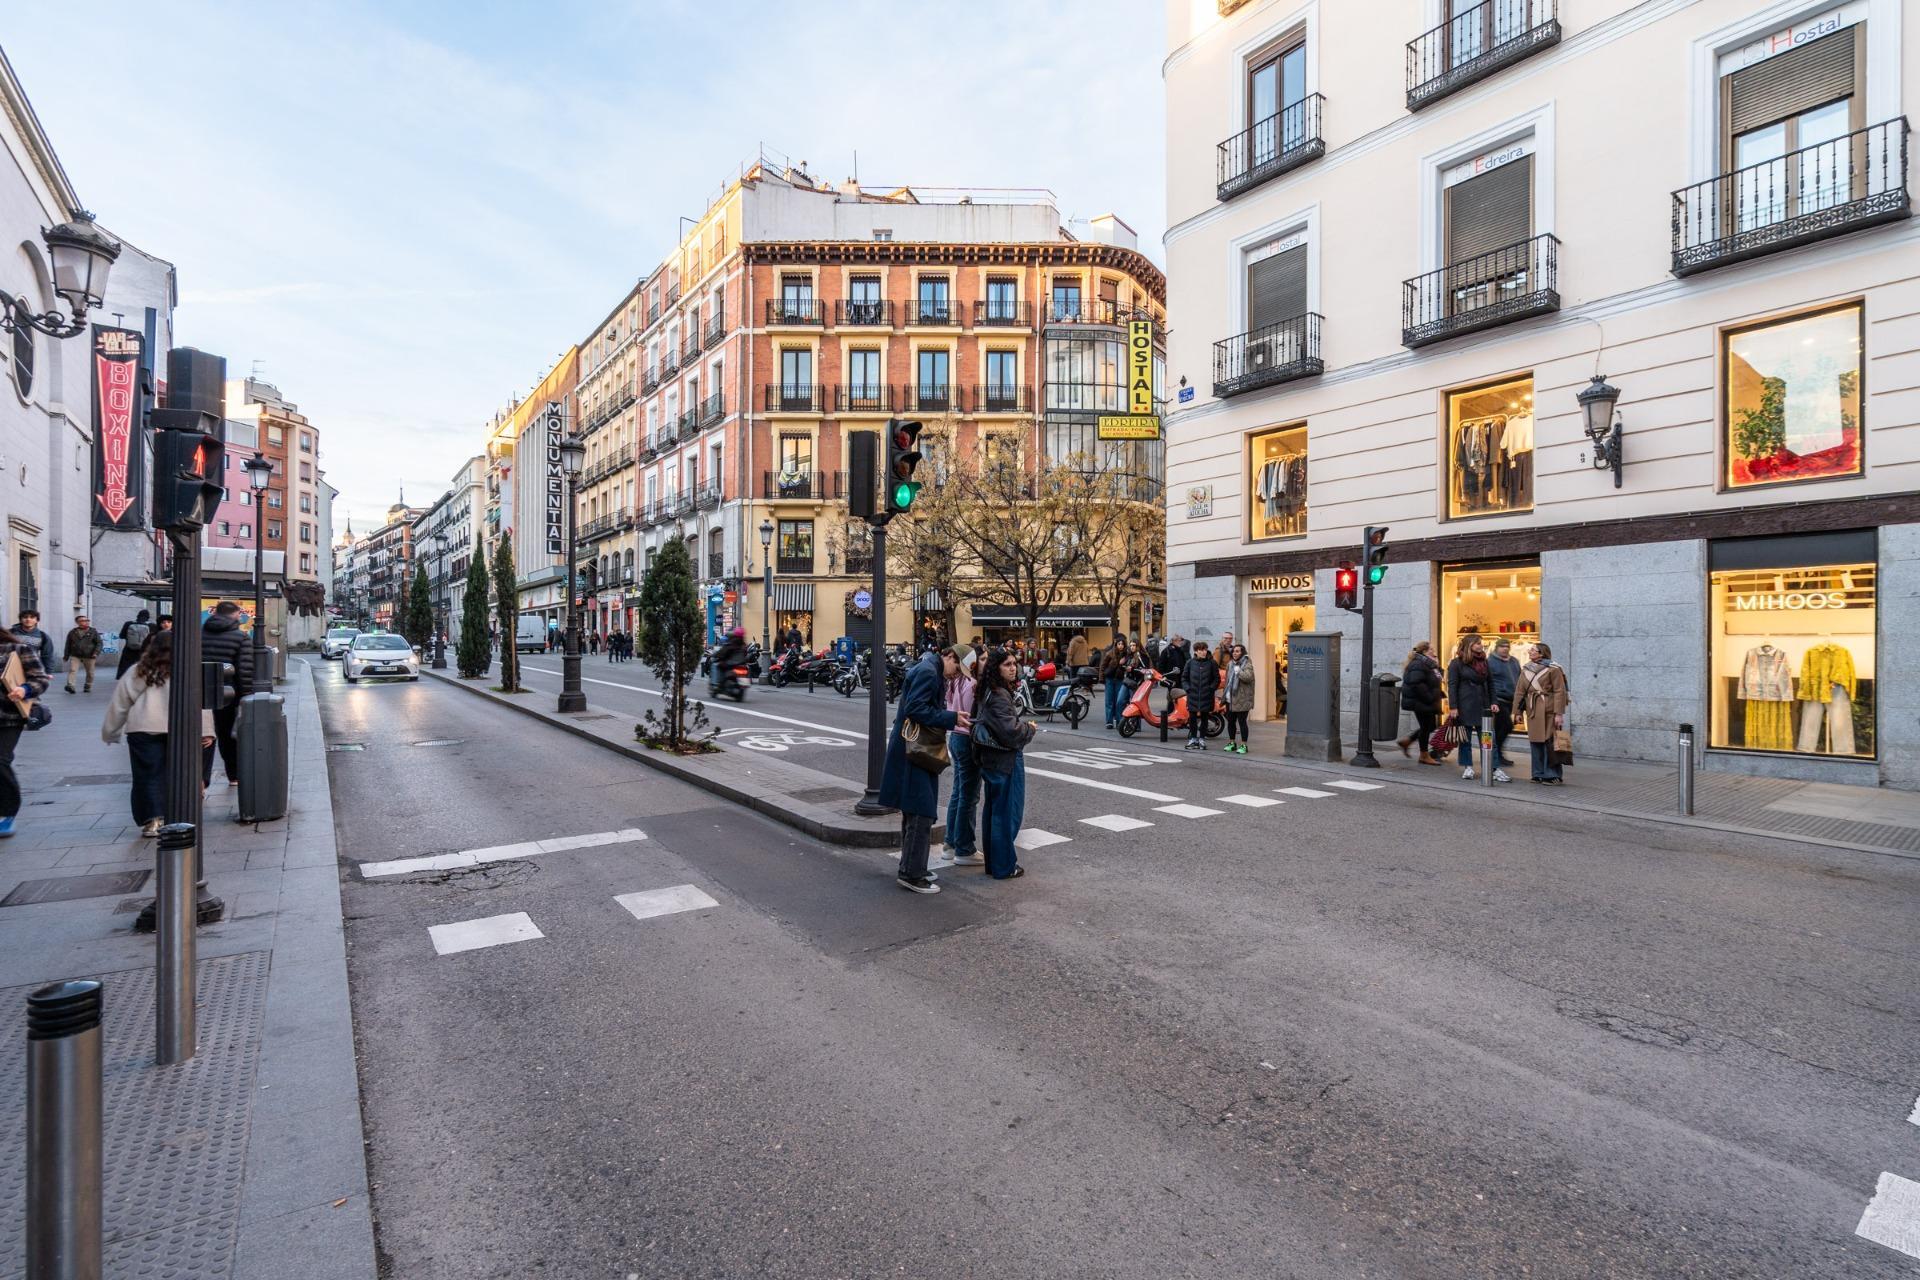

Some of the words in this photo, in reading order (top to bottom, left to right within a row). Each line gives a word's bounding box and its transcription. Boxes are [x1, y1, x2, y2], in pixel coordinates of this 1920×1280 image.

[1771, 13, 1841, 54] Hostal
[1475, 147, 1524, 174] Edreira
[1269, 235, 1301, 257] Hostal
[1132, 322, 1150, 405] HOSTAL
[1101, 417, 1157, 427] EDREIRA
[109, 362, 130, 511] BOXING
[547, 401, 562, 554] MONUMENTAL
[1251, 576, 1311, 591] MIHOOS
[1736, 592, 1847, 610] MIHOOS
[1023, 747, 1183, 770] BUS
